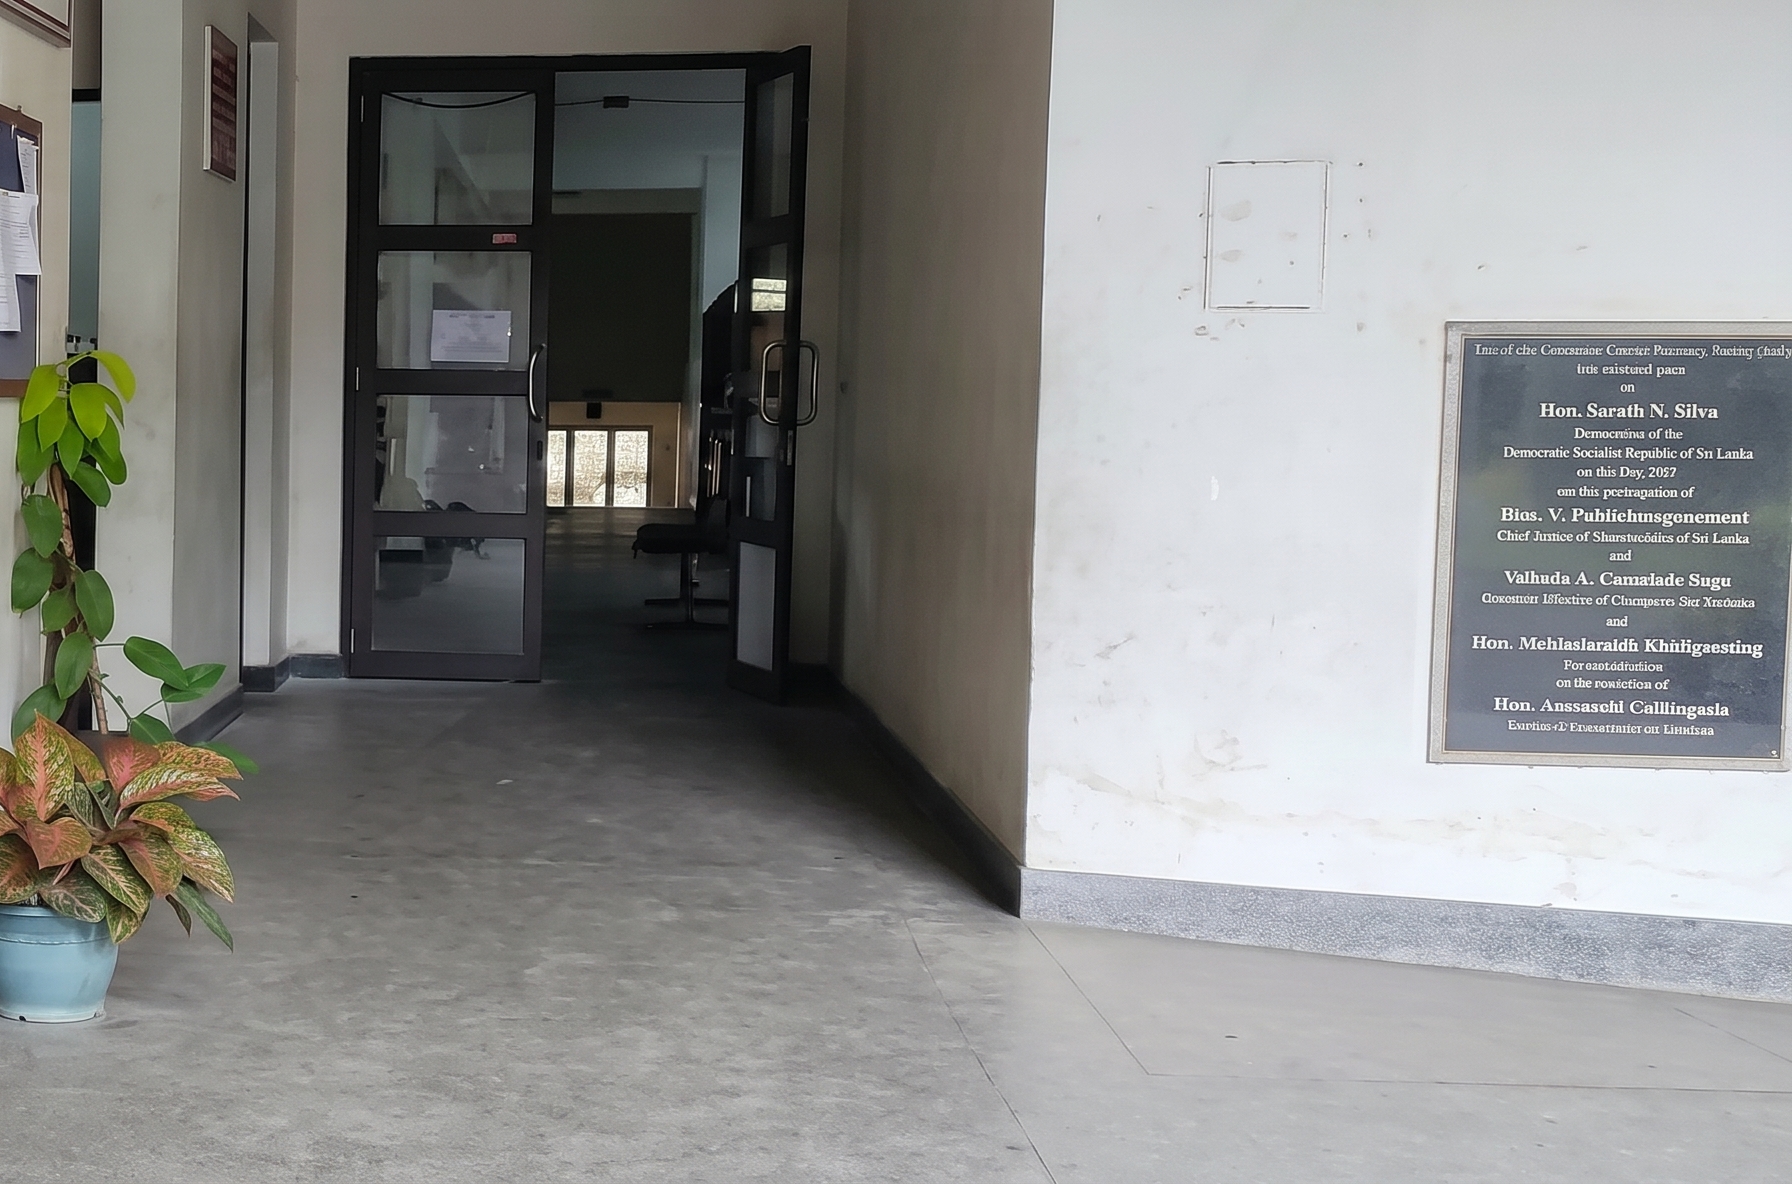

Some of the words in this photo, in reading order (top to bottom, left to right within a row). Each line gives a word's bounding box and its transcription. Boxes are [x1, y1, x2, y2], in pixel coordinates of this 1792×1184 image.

[1620, 383, 1636, 393] on
[1539, 402, 1583, 418] Hon.
[1586, 402, 1645, 418] Sarath
[1649, 403, 1669, 419] N.
[1673, 403, 1719, 419] Silva
[1648, 427, 1664, 440] of
[1664, 428, 1684, 440] the
[1503, 445, 1570, 459] Democratic
[1572, 446, 1623, 459] Socialist
[1625, 446, 1678, 462] Republic
[1679, 447, 1695, 459] of
[1715, 447, 1754, 460] Lanka
[1576, 468, 1593, 478] on
[1595, 465, 1617, 478] this
[1578, 485, 1600, 497] this
[1680, 486, 1696, 499] of
[1547, 507, 1566, 523] V.
[1496, 529, 1531, 542] Chief
[1575, 530, 1591, 542] of
[1676, 531, 1691, 544] of
[1691, 532, 1709, 544] Sri
[1712, 532, 1750, 545] Lanka
[1609, 549, 1632, 561] and
[1574, 571, 1595, 586] A.
[1688, 573, 1732, 592] Sugu
[1595, 594, 1611, 606] of
[1605, 615, 1628, 627] and
[1471, 635, 1514, 650] Hon.
[1555, 679, 1572, 688] on
[1573, 677, 1593, 689] the
[1654, 678, 1671, 690] of
[1493, 697, 1536, 712] Hon.
